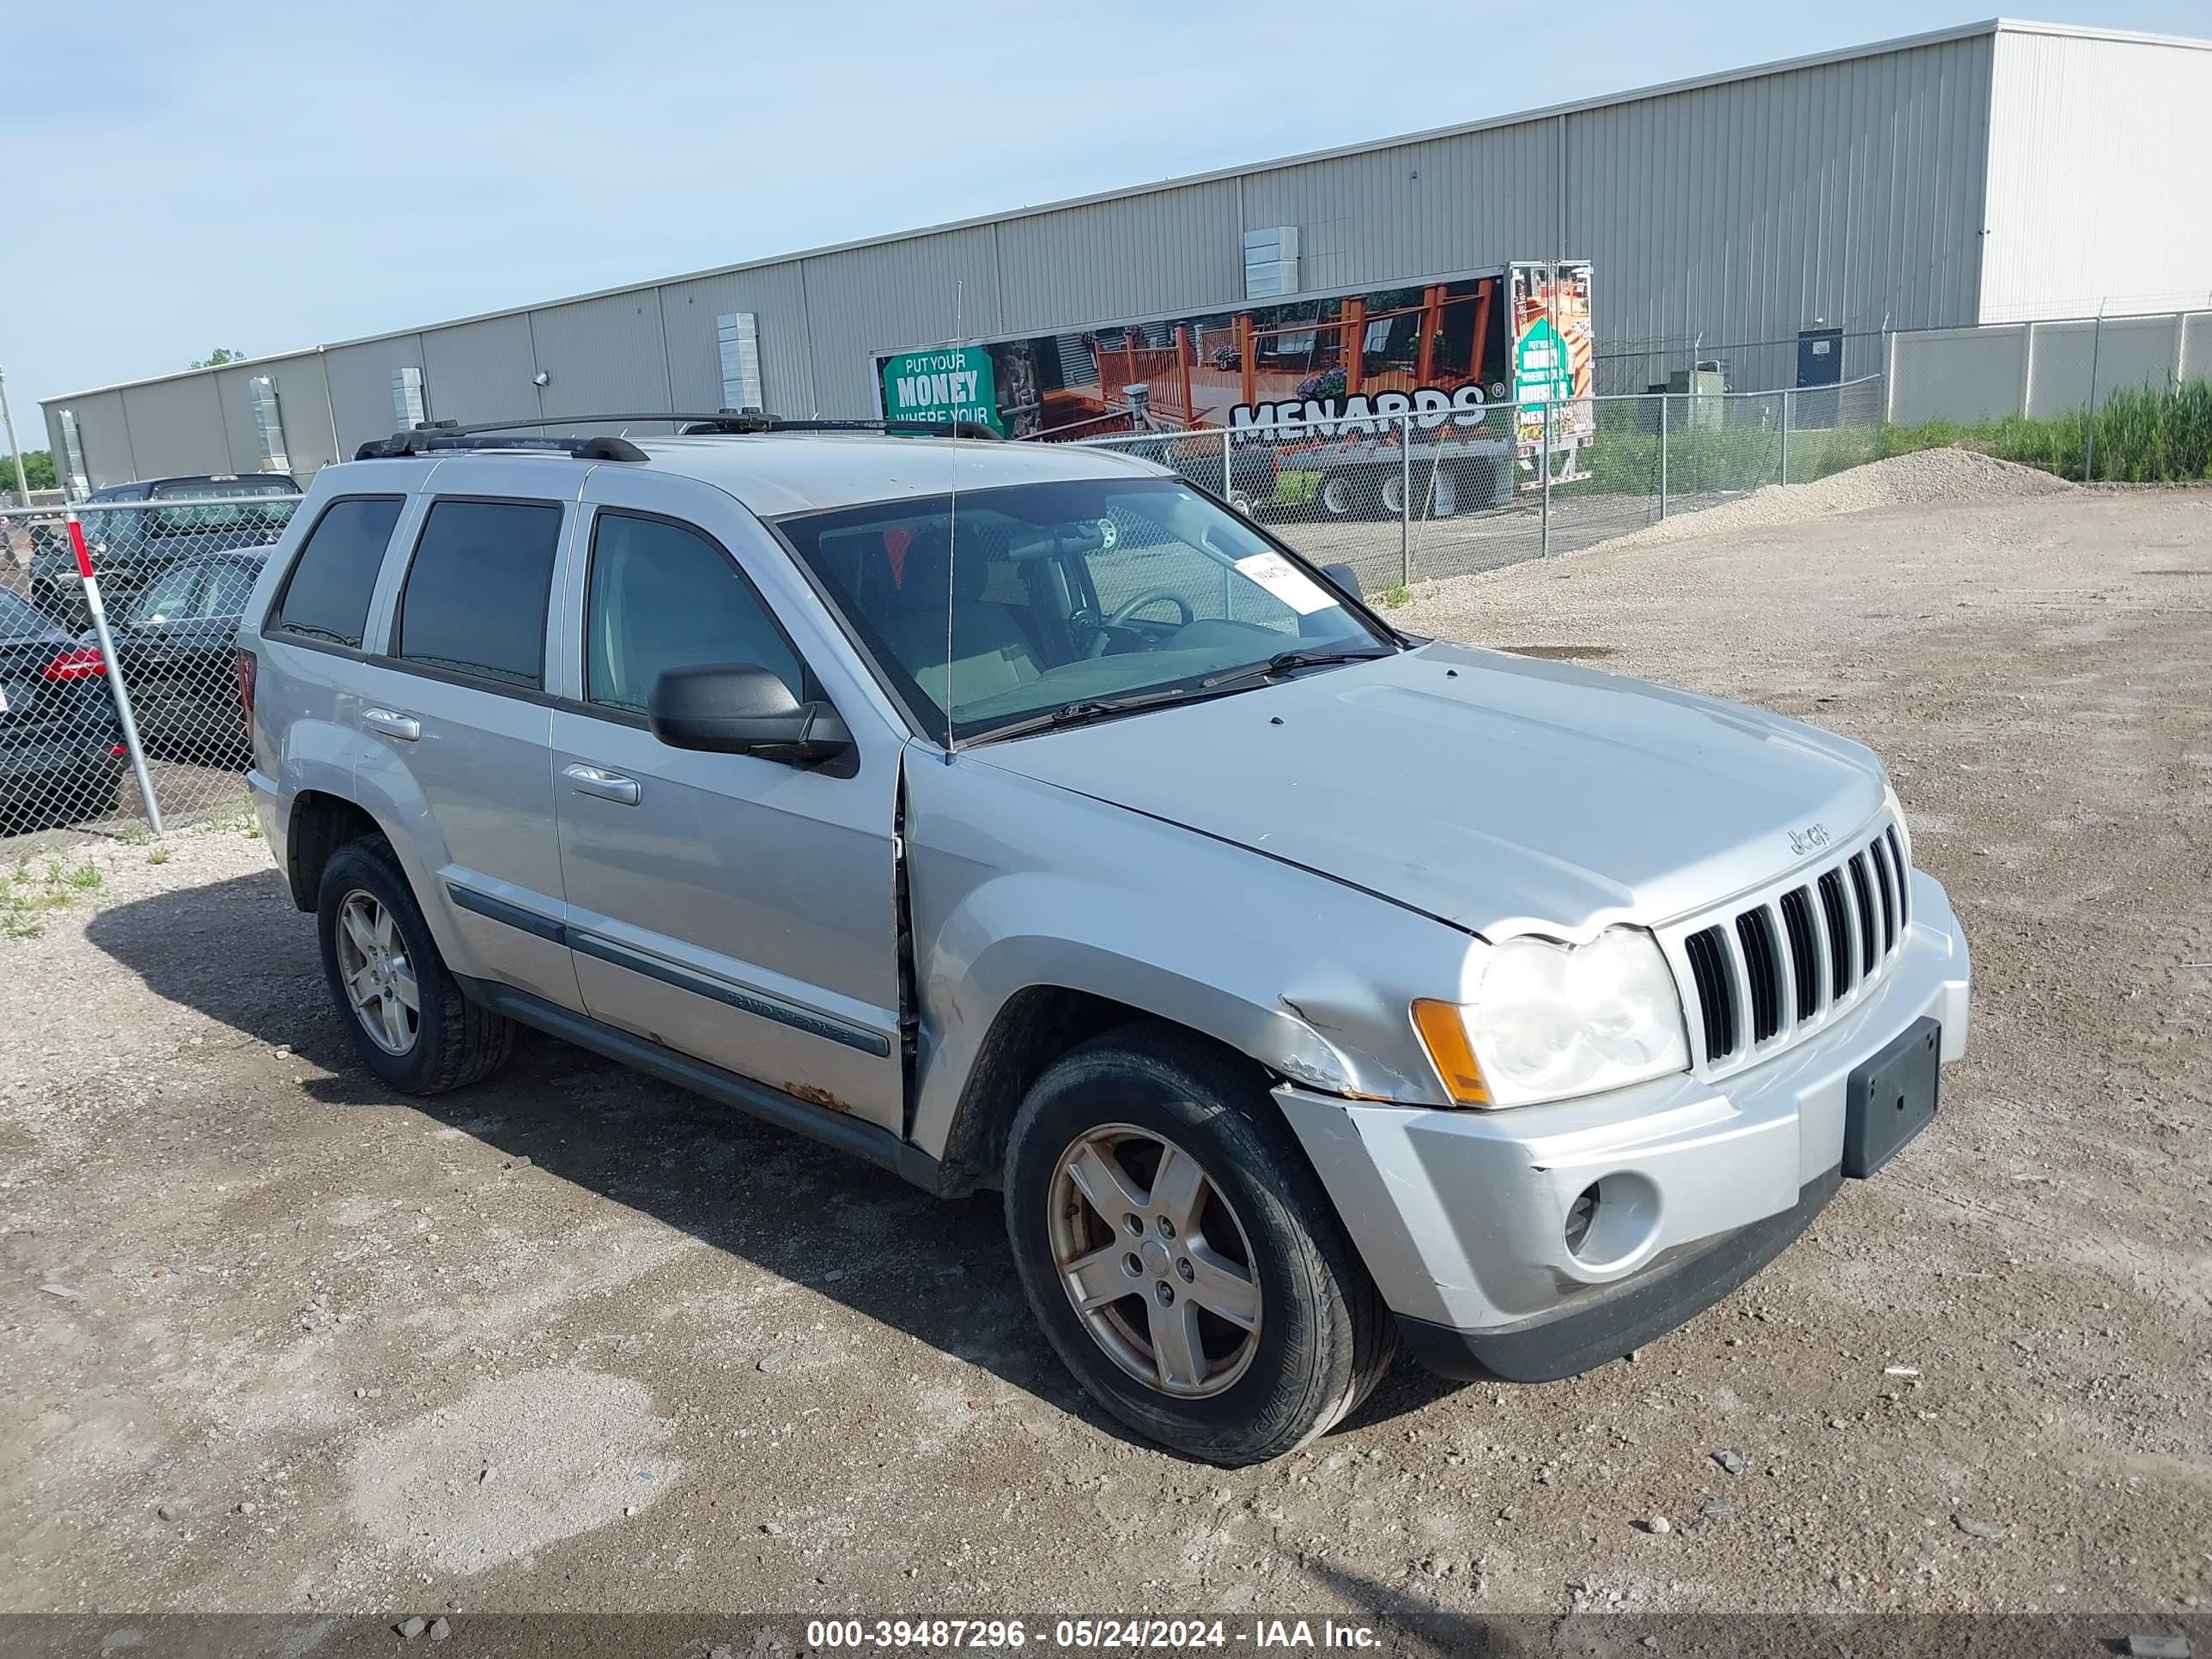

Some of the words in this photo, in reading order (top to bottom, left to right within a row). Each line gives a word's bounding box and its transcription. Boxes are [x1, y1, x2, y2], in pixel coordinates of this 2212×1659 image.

[906, 357, 928, 374] PUT
[930, 354, 966, 372] YOUR
[896, 369, 978, 408] MONEY
[950, 406, 988, 424] YOUR
[1231, 384, 1487, 443] MENARDS
